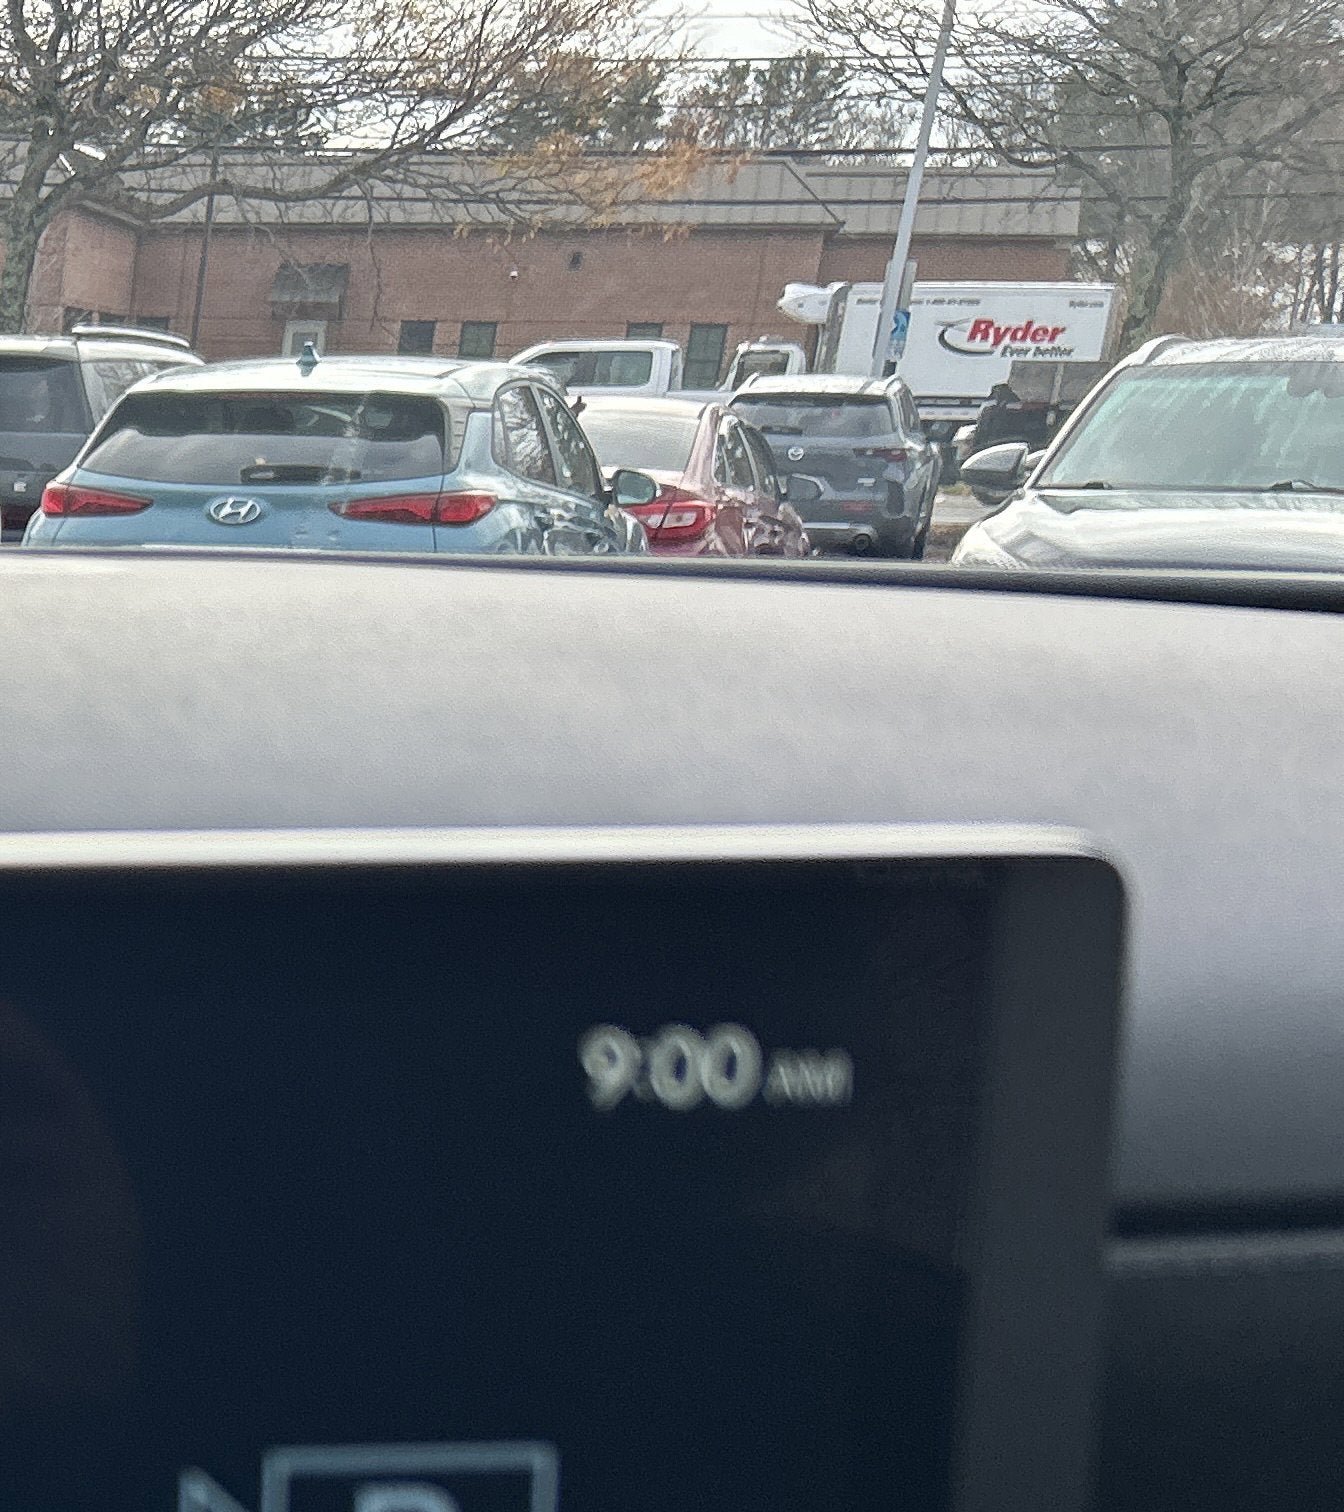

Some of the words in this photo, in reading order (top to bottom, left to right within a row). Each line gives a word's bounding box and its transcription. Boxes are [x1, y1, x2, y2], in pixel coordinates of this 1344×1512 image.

[967, 318, 1066, 349] Ryder
[1001, 344, 1032, 358] Ever
[1033, 345, 1075, 358] better
[578, 1023, 763, 1112] 9:00
[764, 1048, 855, 1107] AM
